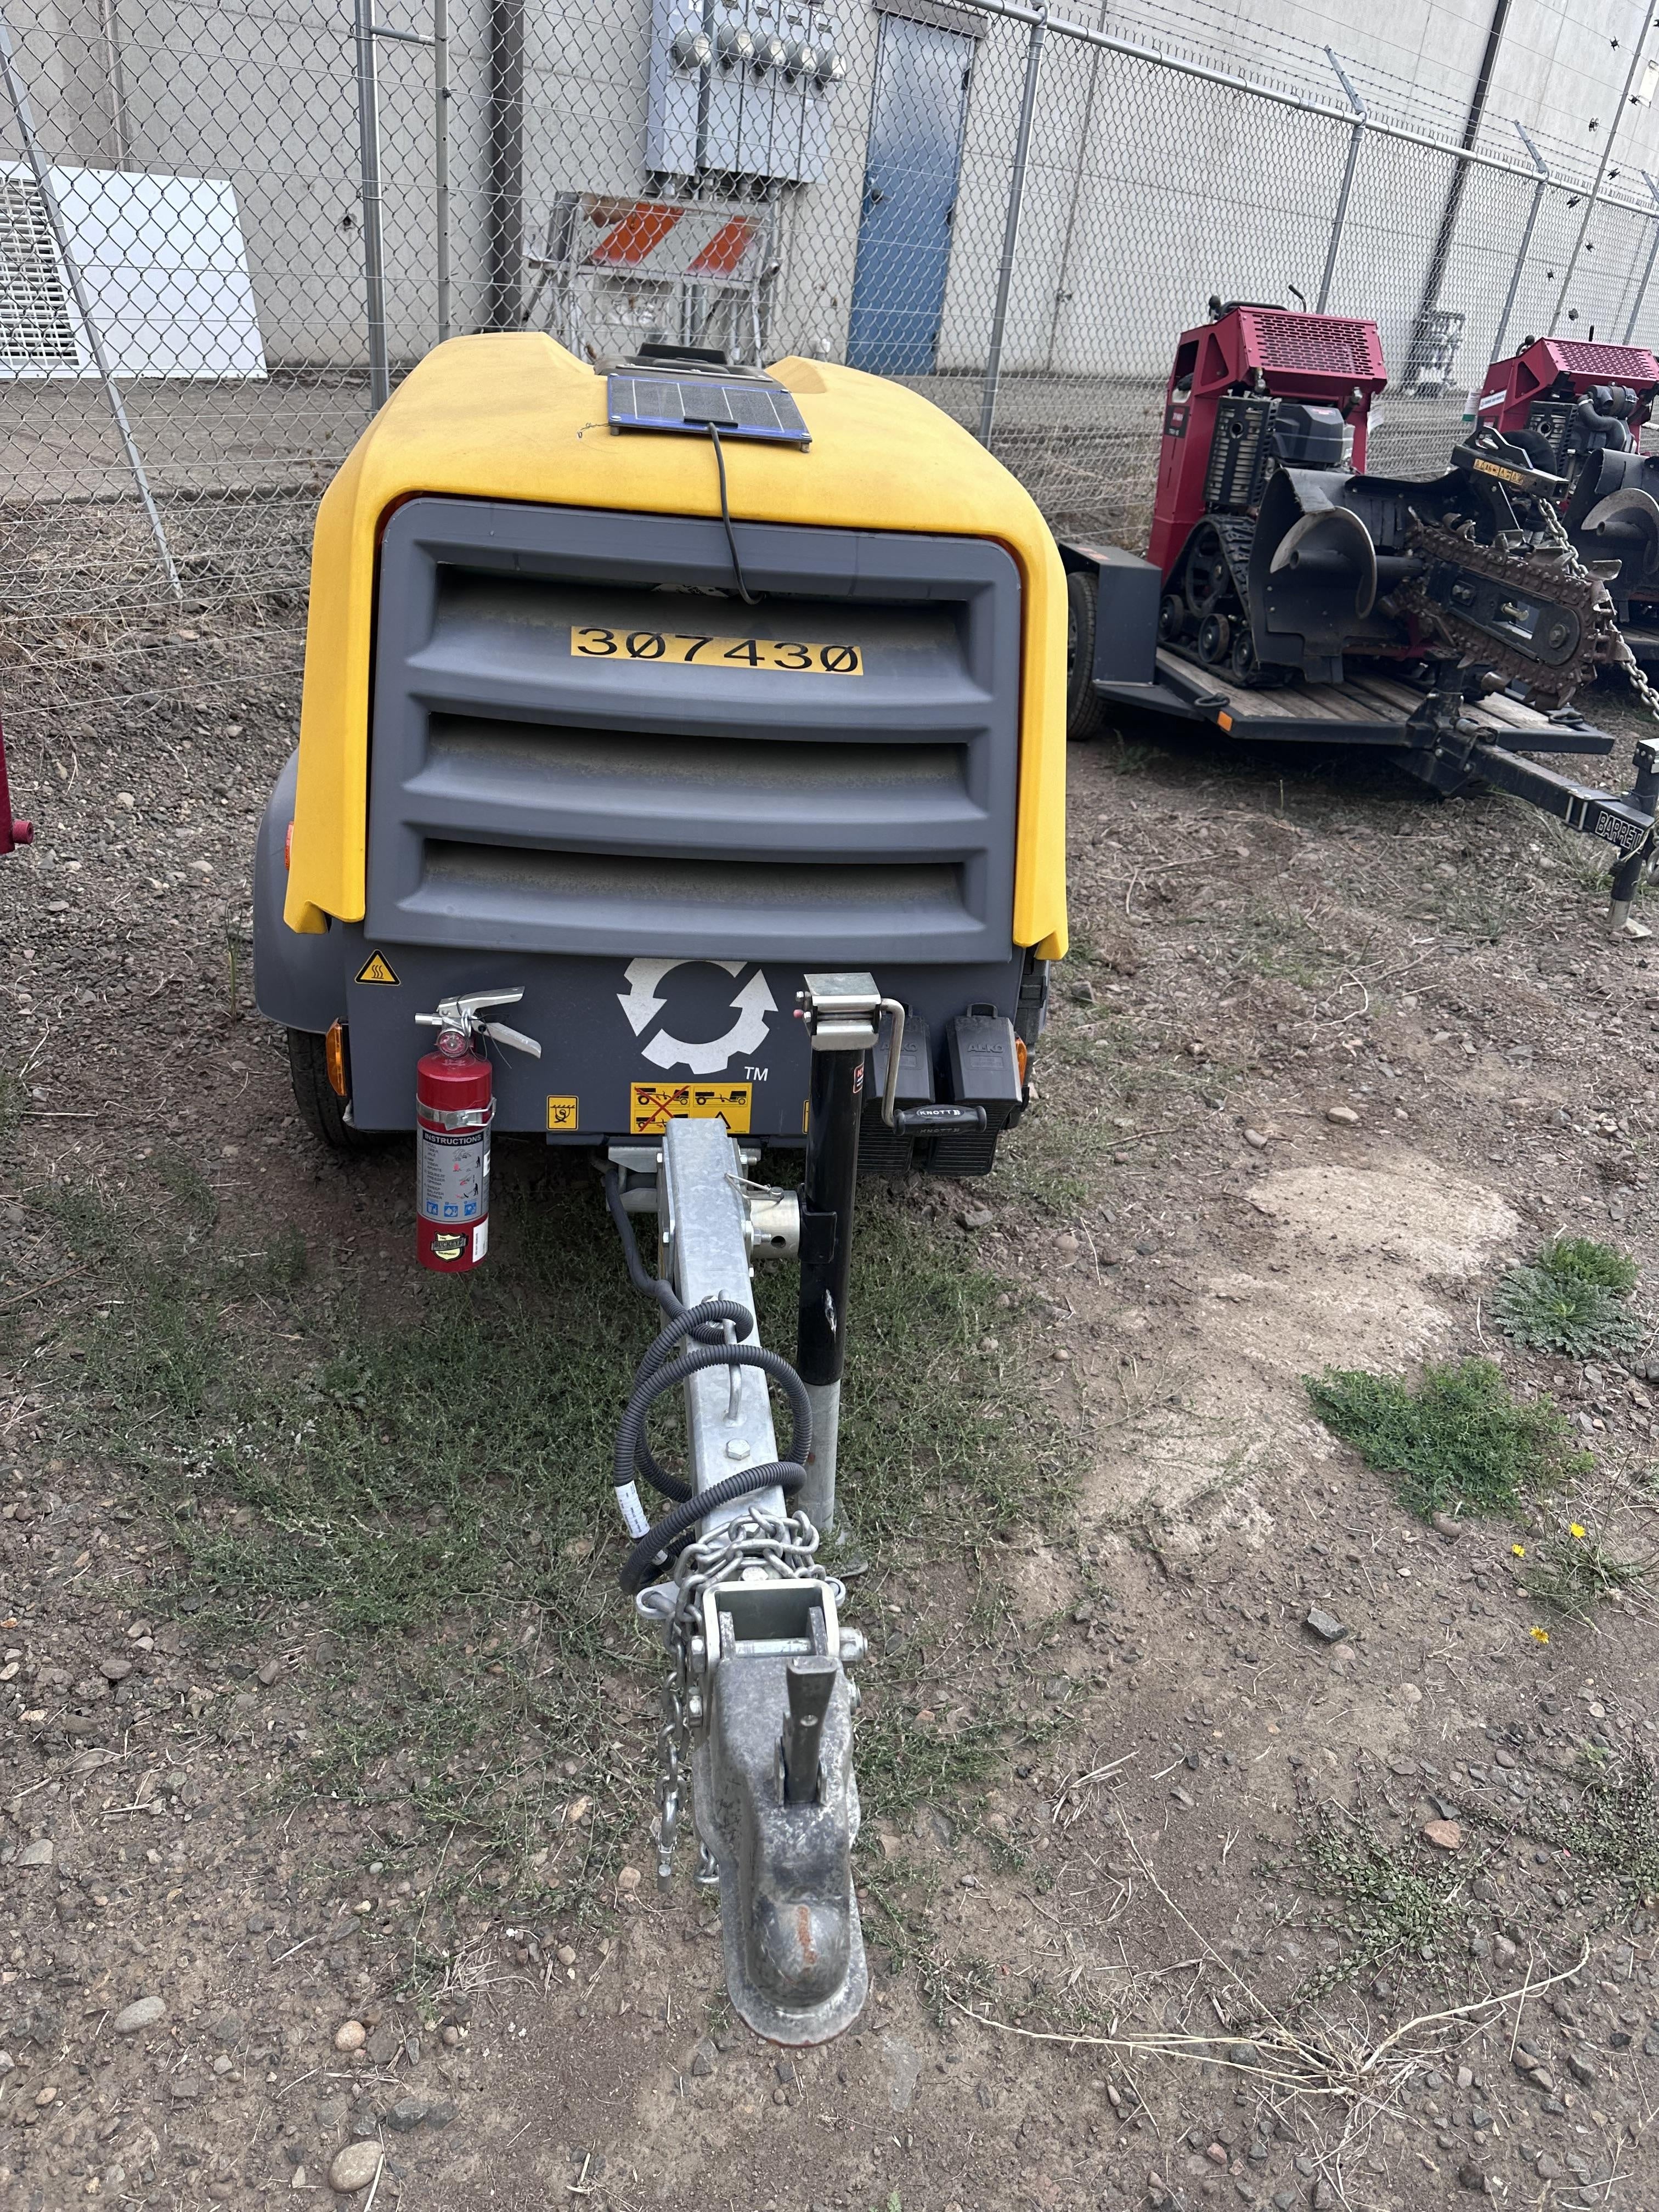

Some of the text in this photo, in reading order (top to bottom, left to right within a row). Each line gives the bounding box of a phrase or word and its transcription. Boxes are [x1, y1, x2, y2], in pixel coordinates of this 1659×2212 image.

[577, 628, 859, 673] 307430
[744, 1066, 769, 1081] TM
[425, 1133, 482, 1145] INSTRUCTIONS
[435, 1238, 464, 1248] BUCKEYE
